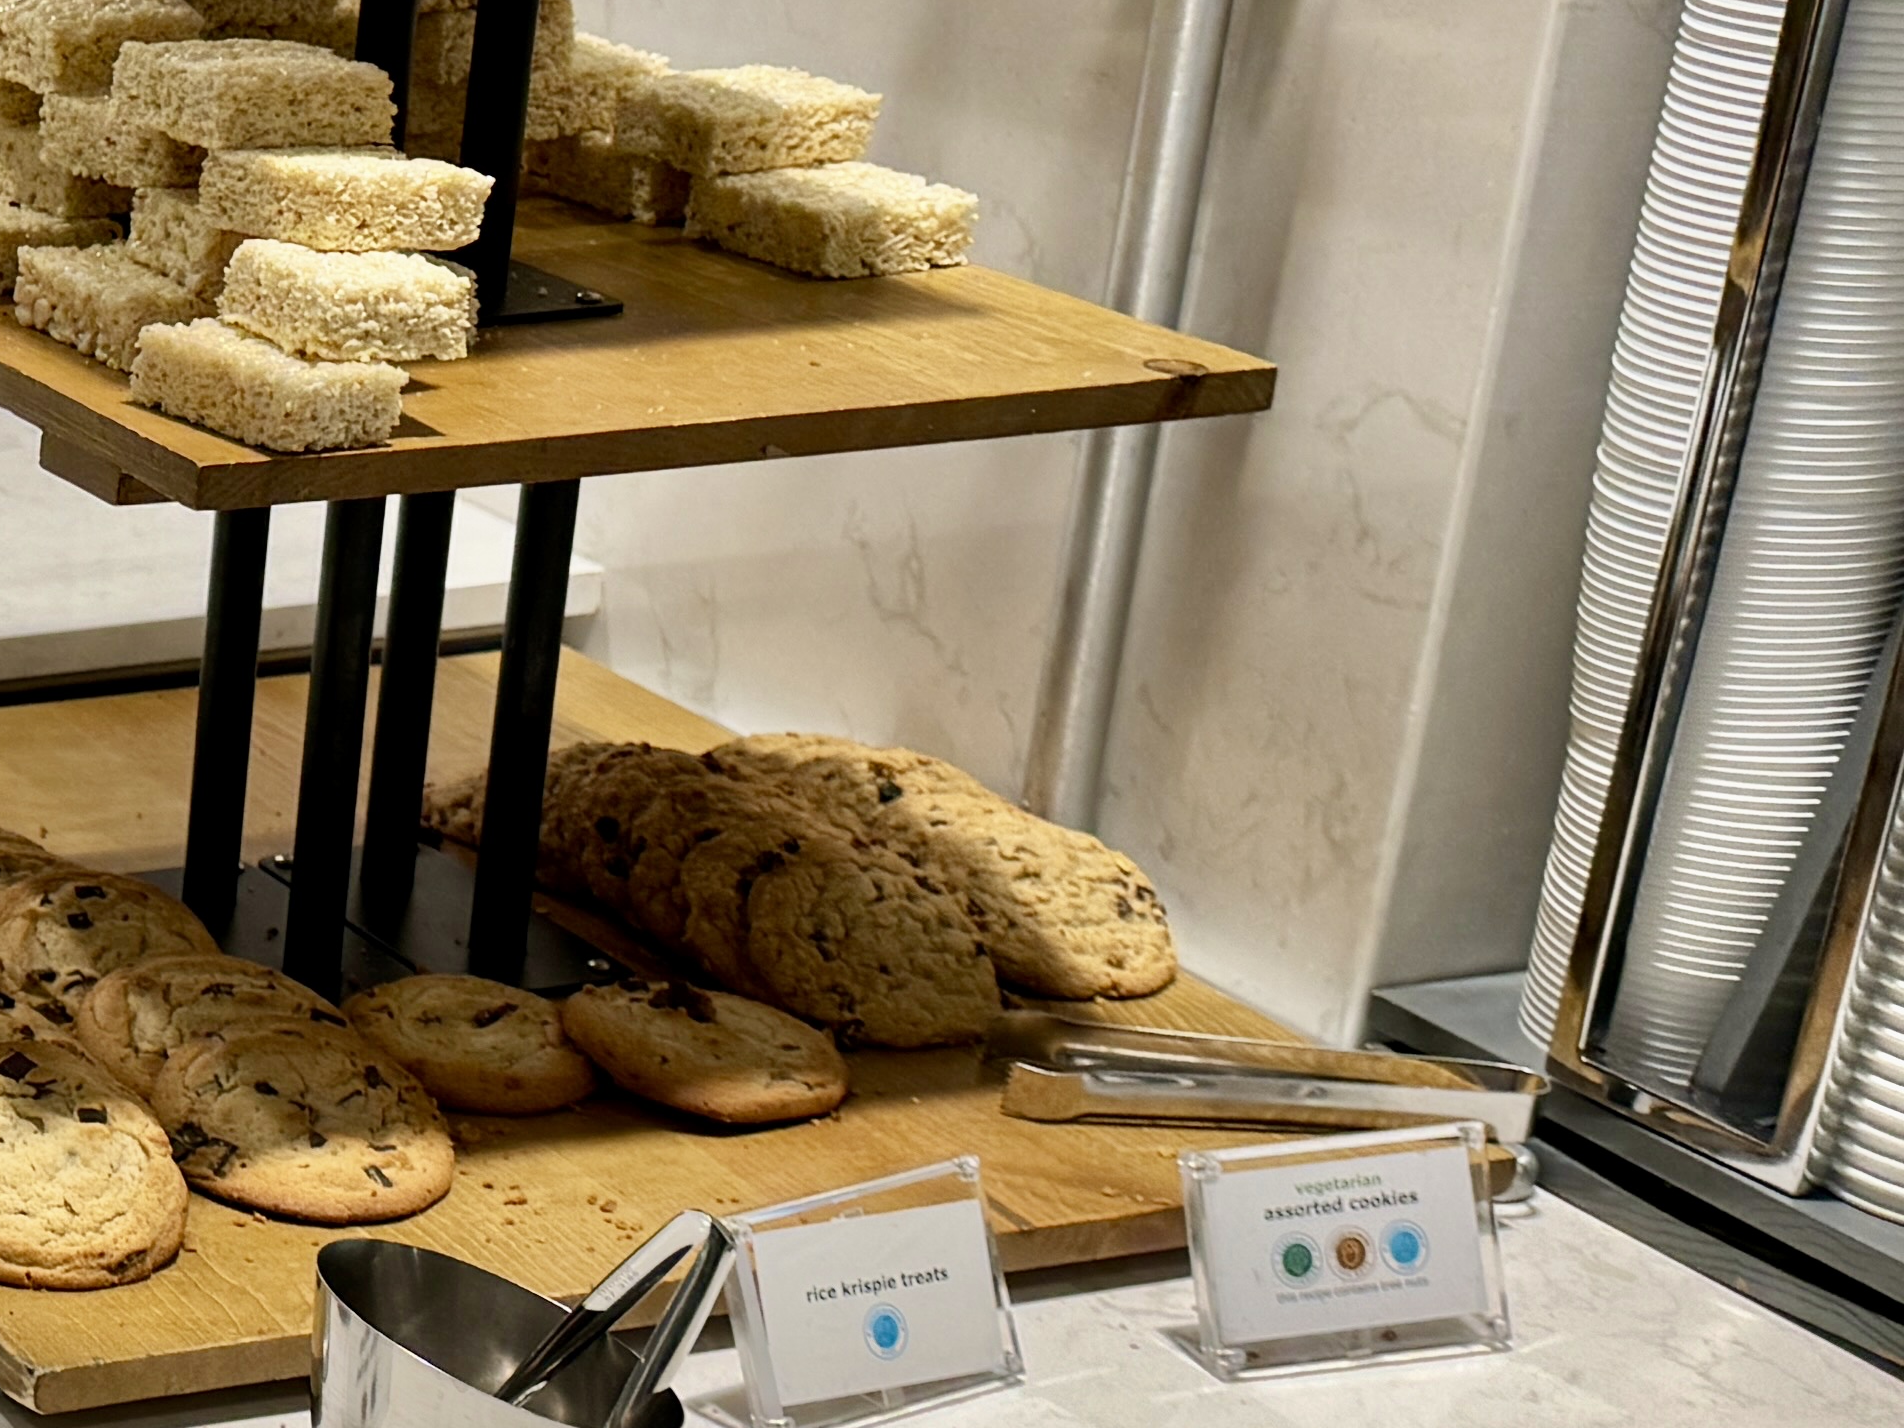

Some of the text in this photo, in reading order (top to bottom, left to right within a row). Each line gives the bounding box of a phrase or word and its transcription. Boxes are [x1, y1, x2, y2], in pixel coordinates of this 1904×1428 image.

[1264, 1191, 1419, 1221] assorted cookies
[806, 1267, 949, 1303] rice krispie treats
